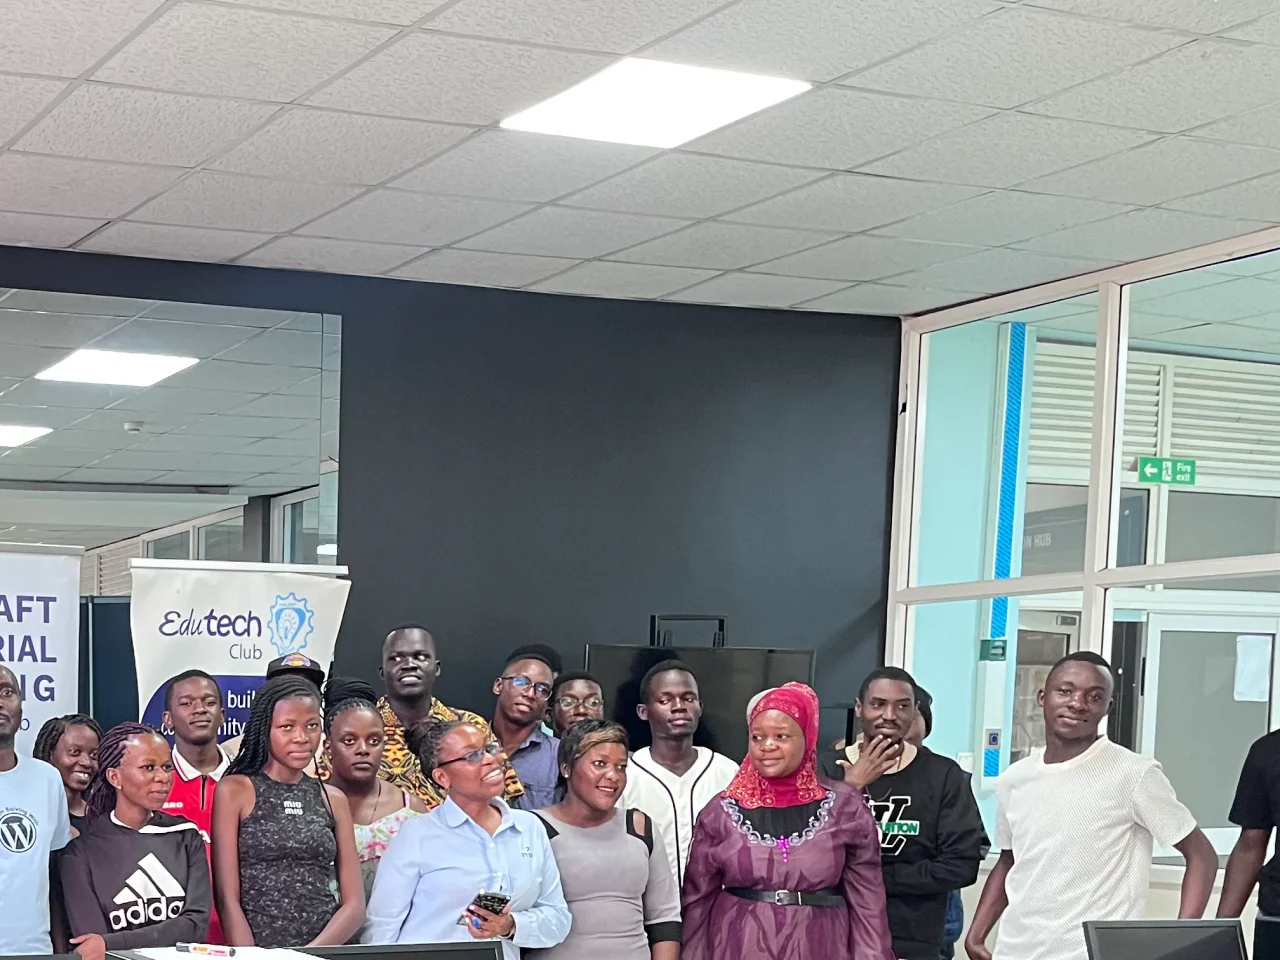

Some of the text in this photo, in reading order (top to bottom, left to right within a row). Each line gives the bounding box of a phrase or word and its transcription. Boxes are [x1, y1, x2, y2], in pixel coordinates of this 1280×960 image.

[1177, 463, 1192, 473] Fire
[1176, 473, 1191, 482] exit
[1034, 533, 1051, 547] HUB
[158, 608, 262, 638] Edutech
[229, 643, 263, 660] Club
[109, 896, 185, 931] adida
